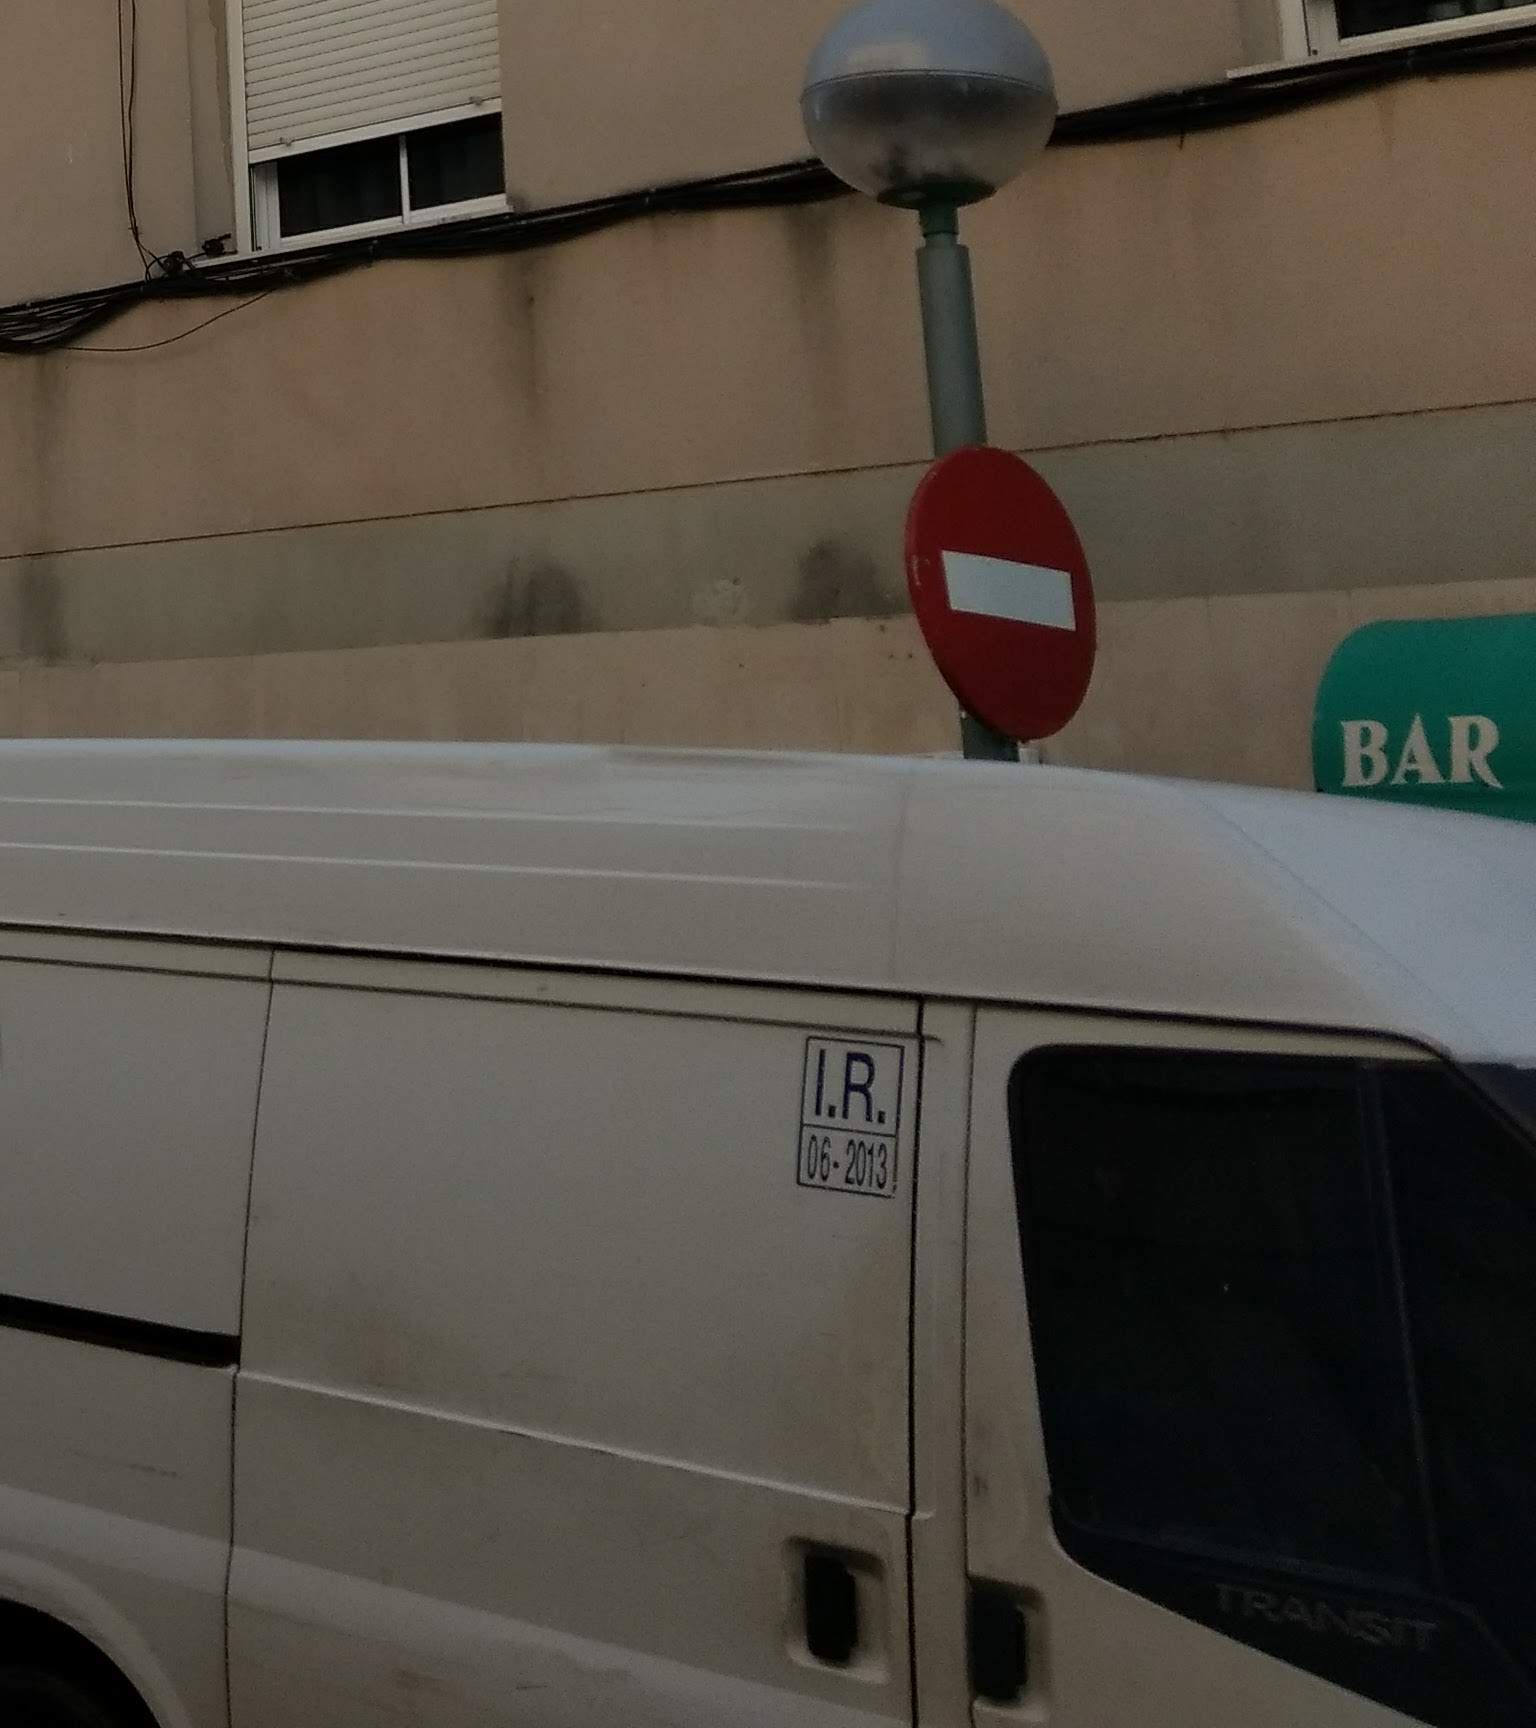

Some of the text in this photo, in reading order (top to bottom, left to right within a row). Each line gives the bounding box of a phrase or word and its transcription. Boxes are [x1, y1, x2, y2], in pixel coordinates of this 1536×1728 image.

[1340, 713, 1504, 790] BAR
[814, 1049, 886, 1125] I.R.
[1215, 1583, 1440, 1650] TRANSIT
